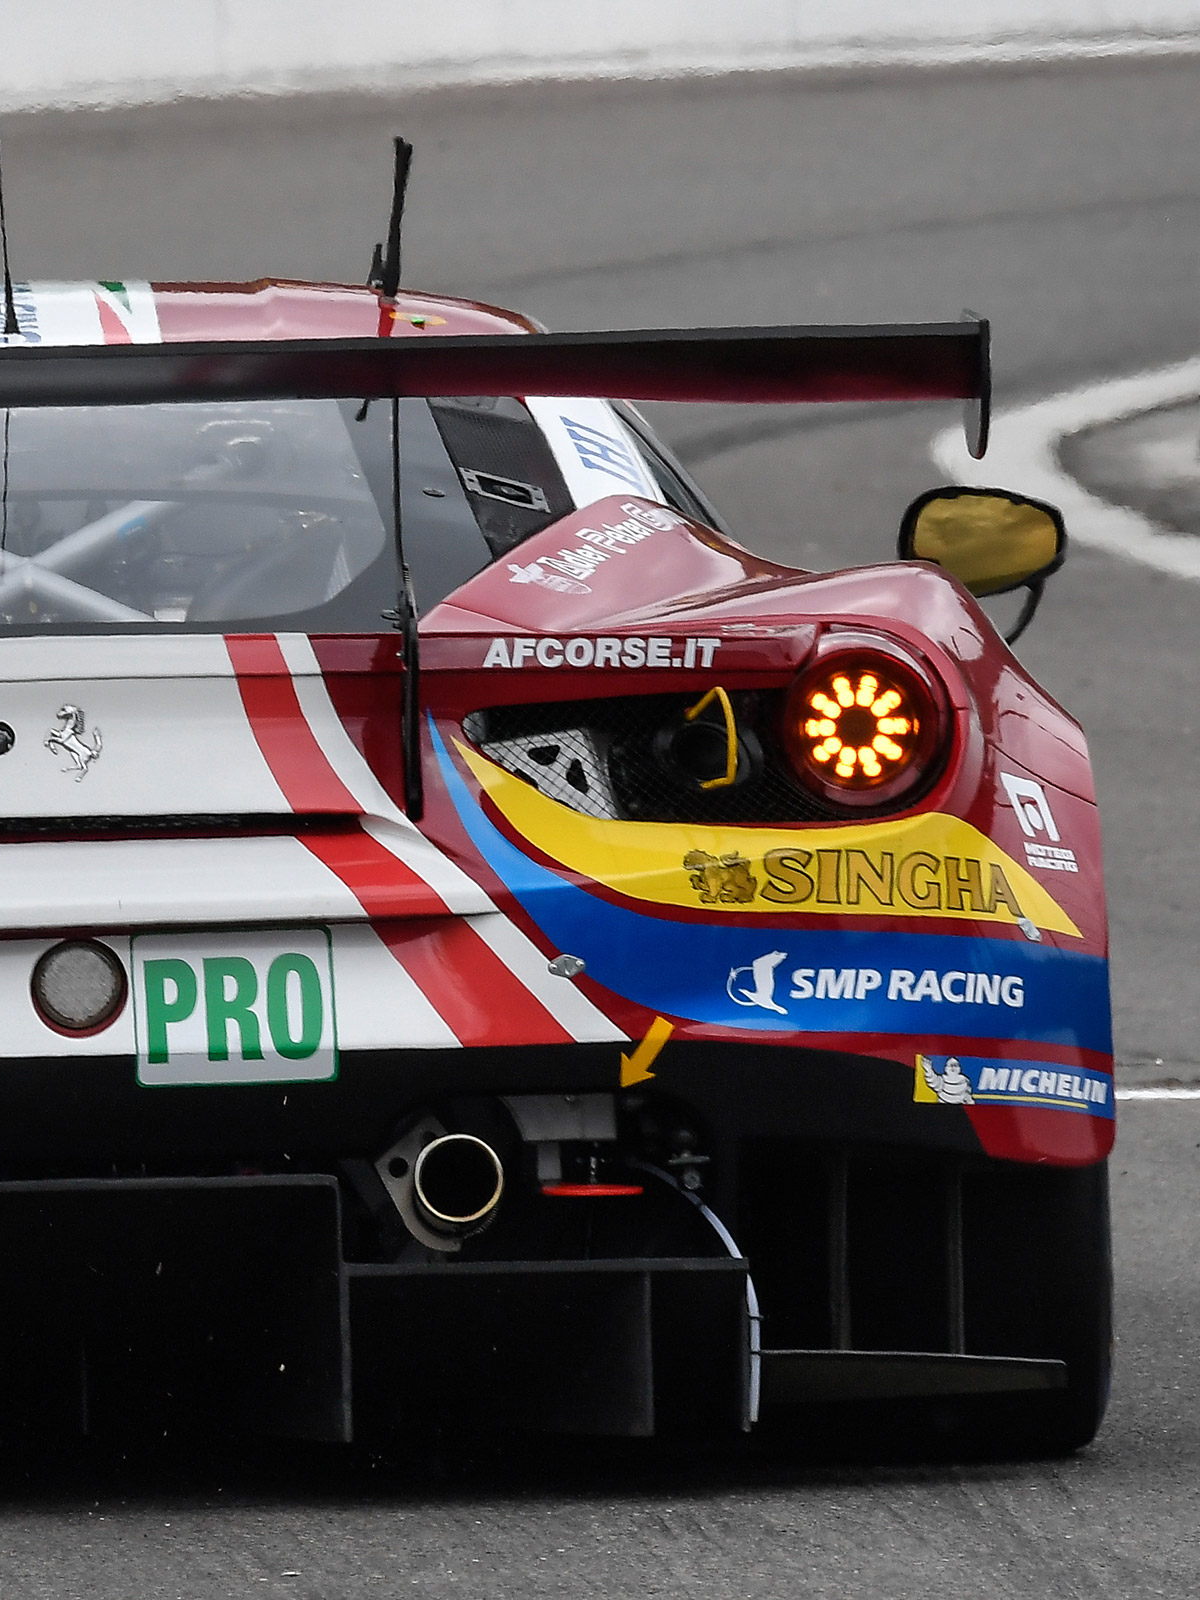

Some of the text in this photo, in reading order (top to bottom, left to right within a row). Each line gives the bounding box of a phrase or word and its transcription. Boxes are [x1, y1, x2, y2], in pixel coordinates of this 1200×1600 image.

[575, 518, 656, 554] Pelzer
[482, 637, 722, 669] AFCORSE.IT
[759, 847, 1023, 918] SINGHA
[789, 968, 1026, 1008] SMP RACING
[143, 952, 323, 1064] PRO
[977, 1066, 1108, 1105] MICHELIN
